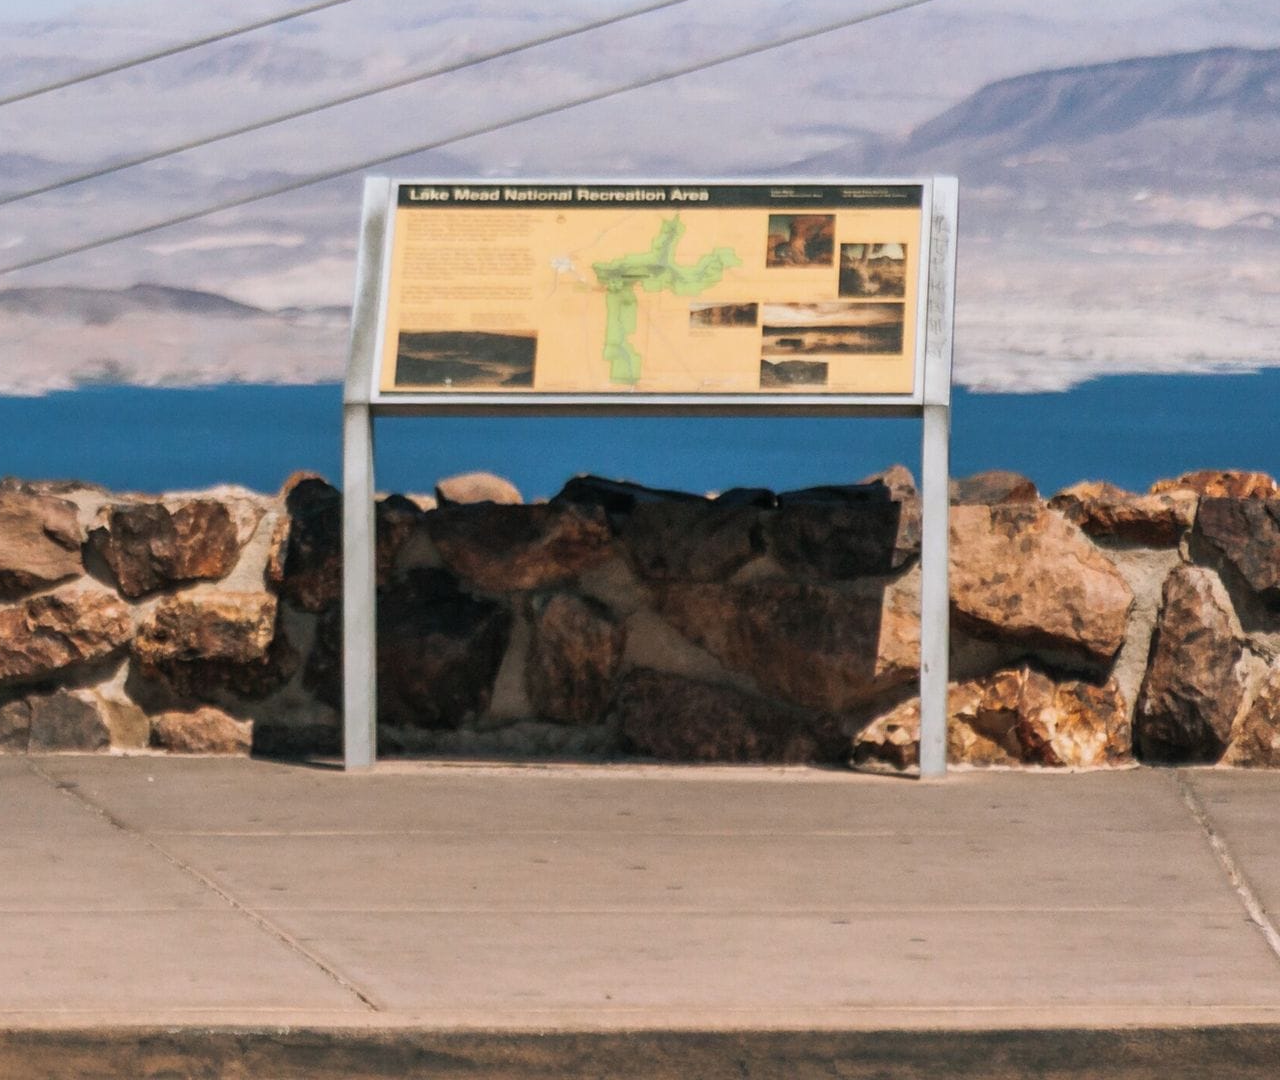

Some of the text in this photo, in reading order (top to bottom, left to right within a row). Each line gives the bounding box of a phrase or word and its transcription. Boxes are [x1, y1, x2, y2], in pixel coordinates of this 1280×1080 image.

[410, 188, 709, 201] Lake Mead National Recreation Area
